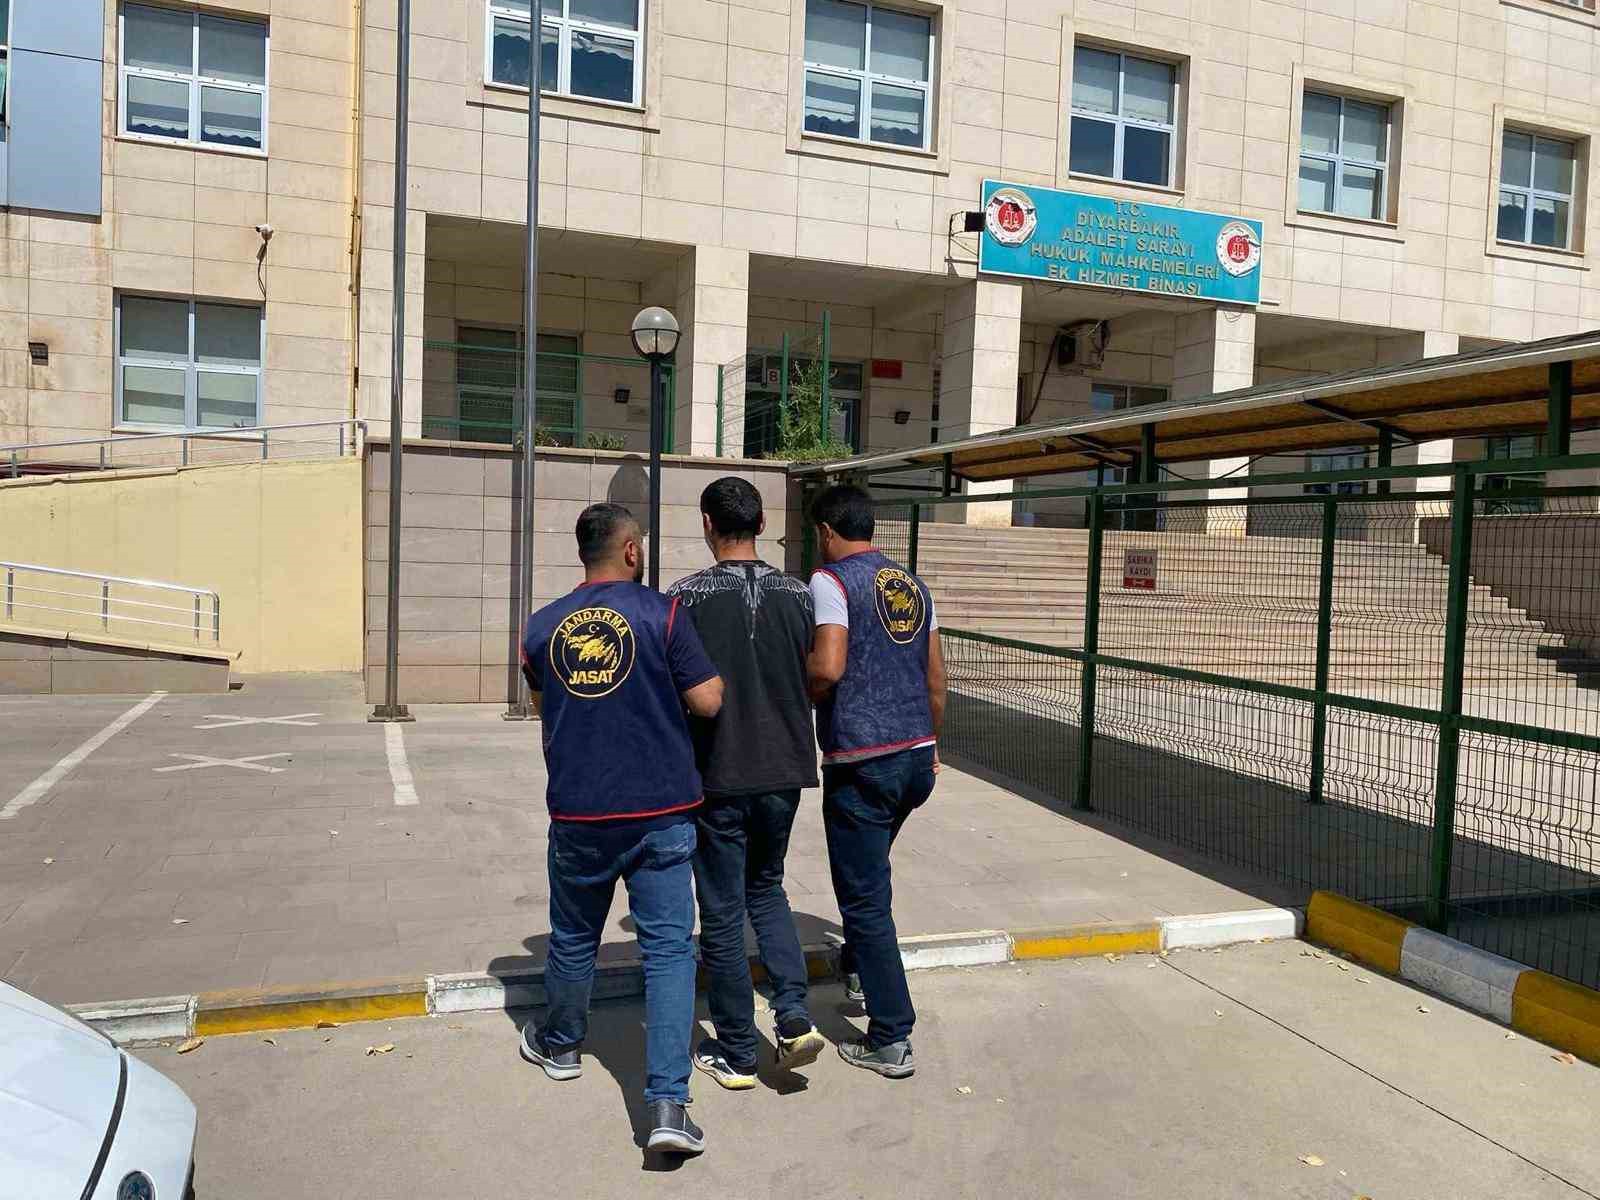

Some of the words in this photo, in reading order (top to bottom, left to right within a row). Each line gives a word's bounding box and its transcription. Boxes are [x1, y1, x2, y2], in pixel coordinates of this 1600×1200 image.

[1031, 242, 1089, 262] HUKUK
[1061, 227, 1128, 249] ADALET
[1136, 236, 1194, 259] SARAYI
[1048, 264, 1070, 280] EK
[560, 611, 628, 638] JANDARMA
[569, 670, 615, 684] JASAT
